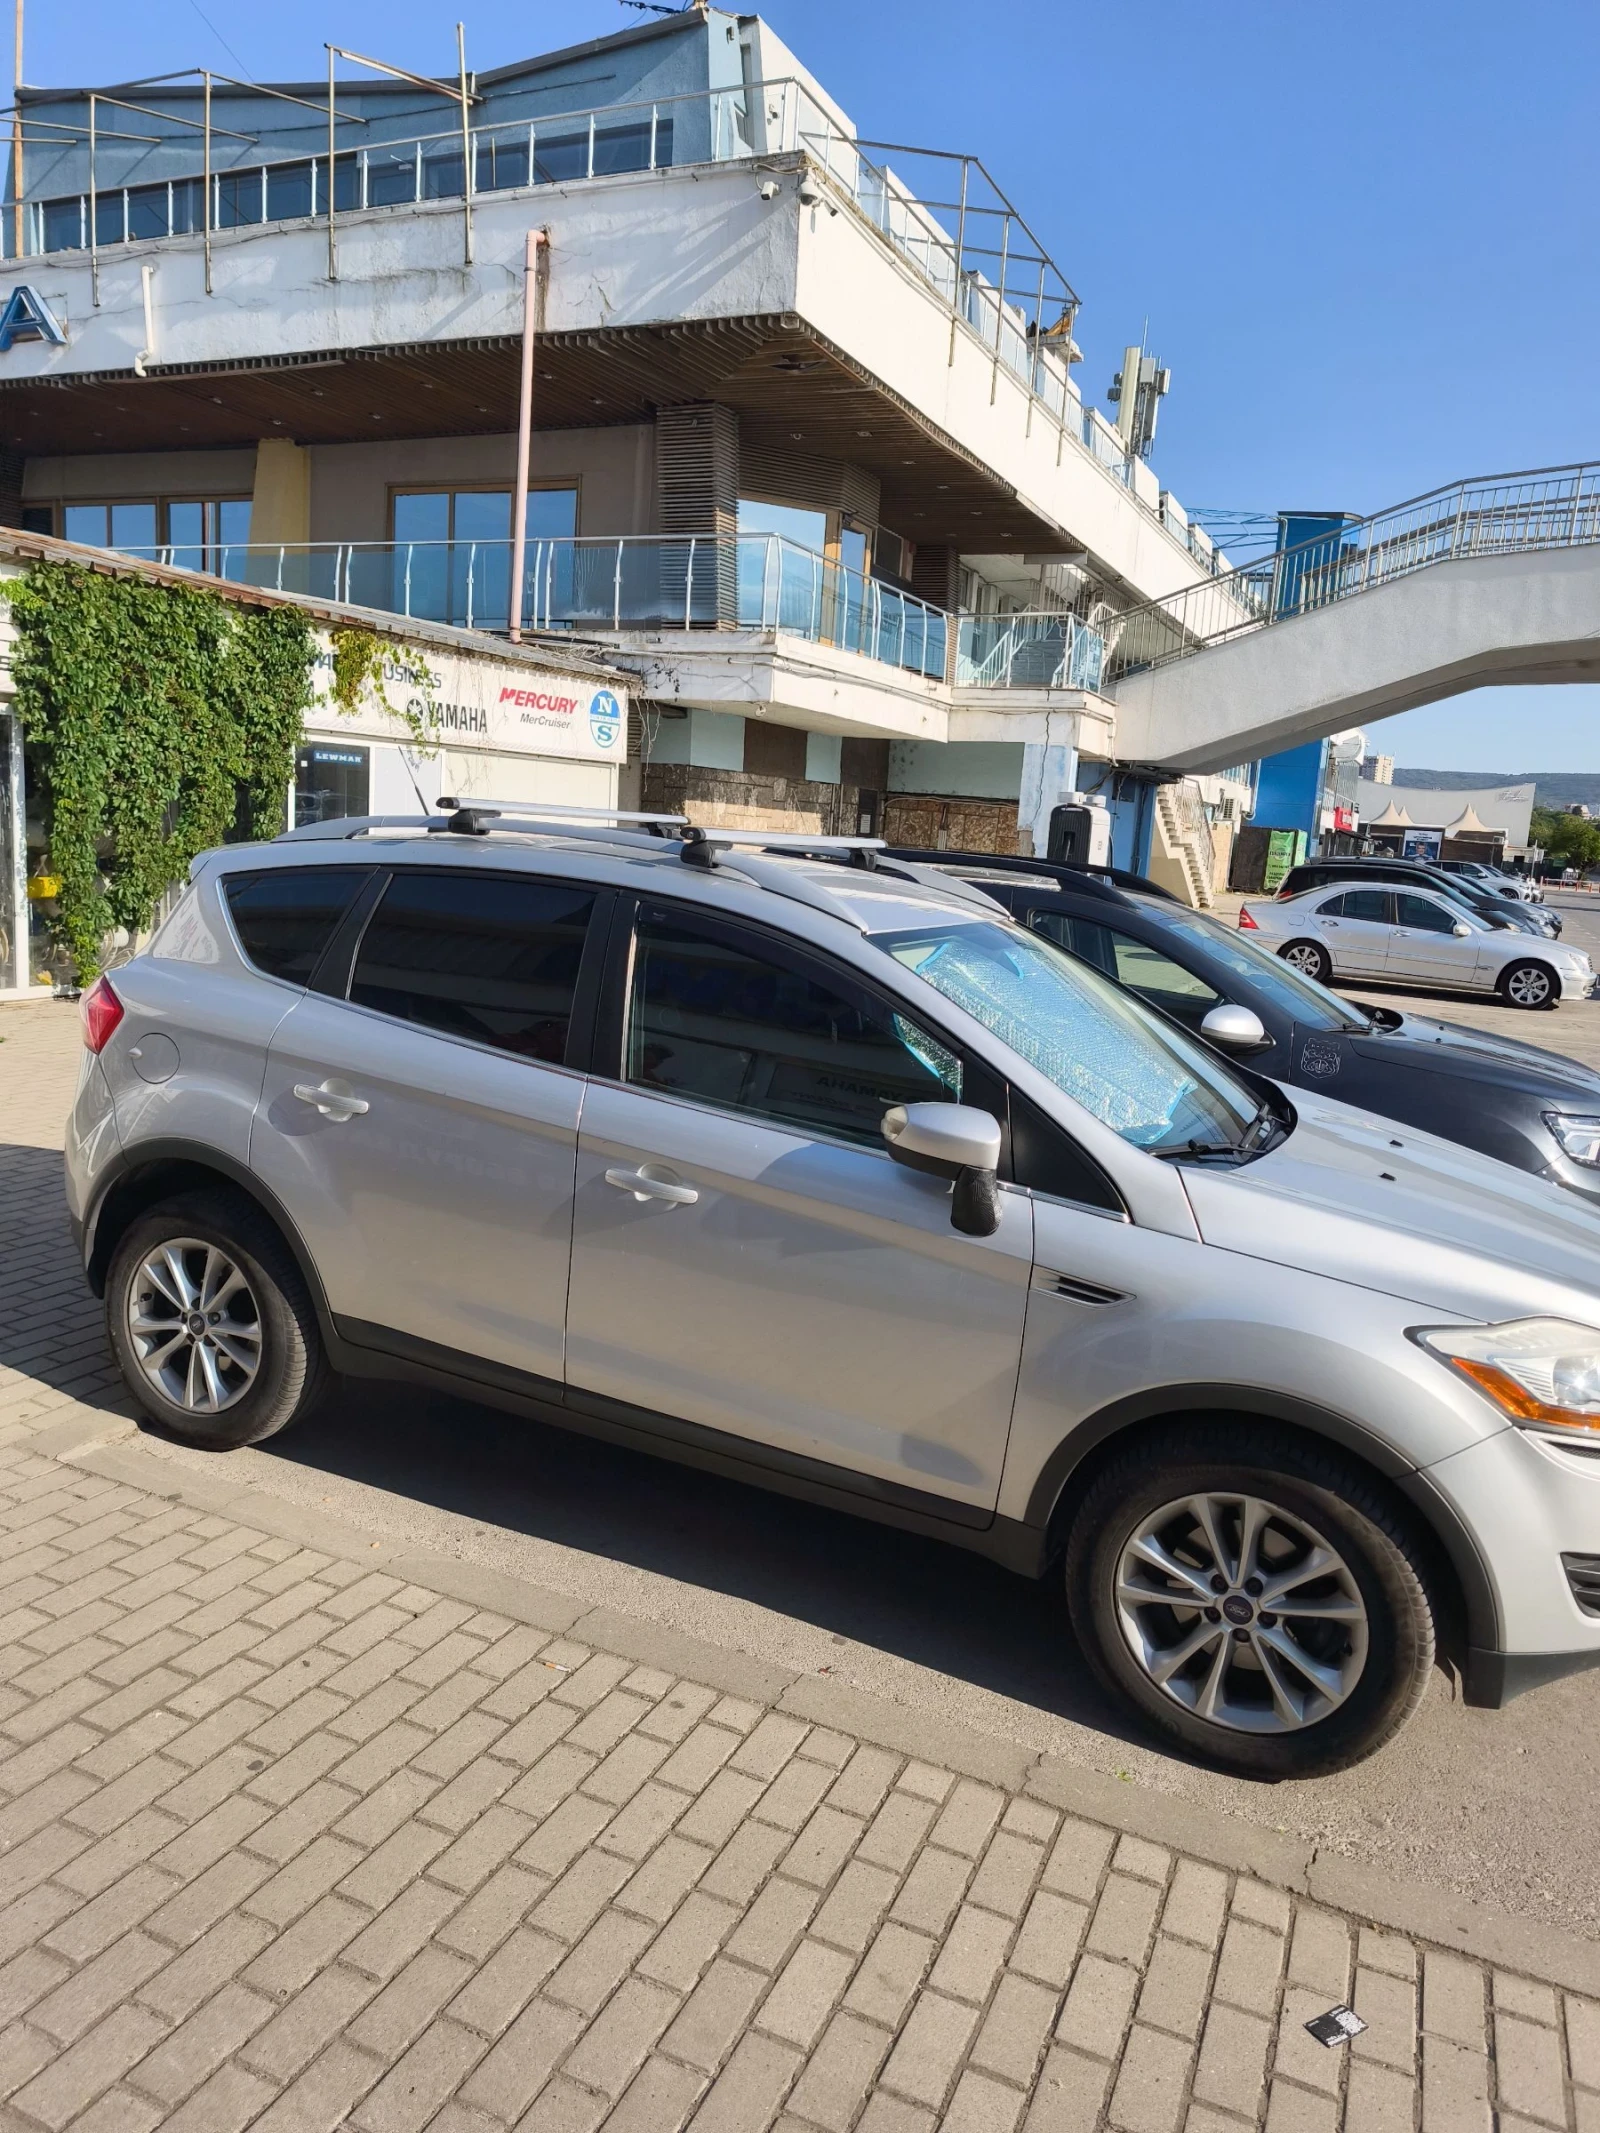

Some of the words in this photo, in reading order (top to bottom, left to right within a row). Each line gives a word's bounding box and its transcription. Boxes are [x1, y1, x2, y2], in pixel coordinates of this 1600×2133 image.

[499, 686, 578, 715] MERCURY
[427, 700, 488, 734] YAMAHA
[520, 712, 571, 730] MerCruiser
